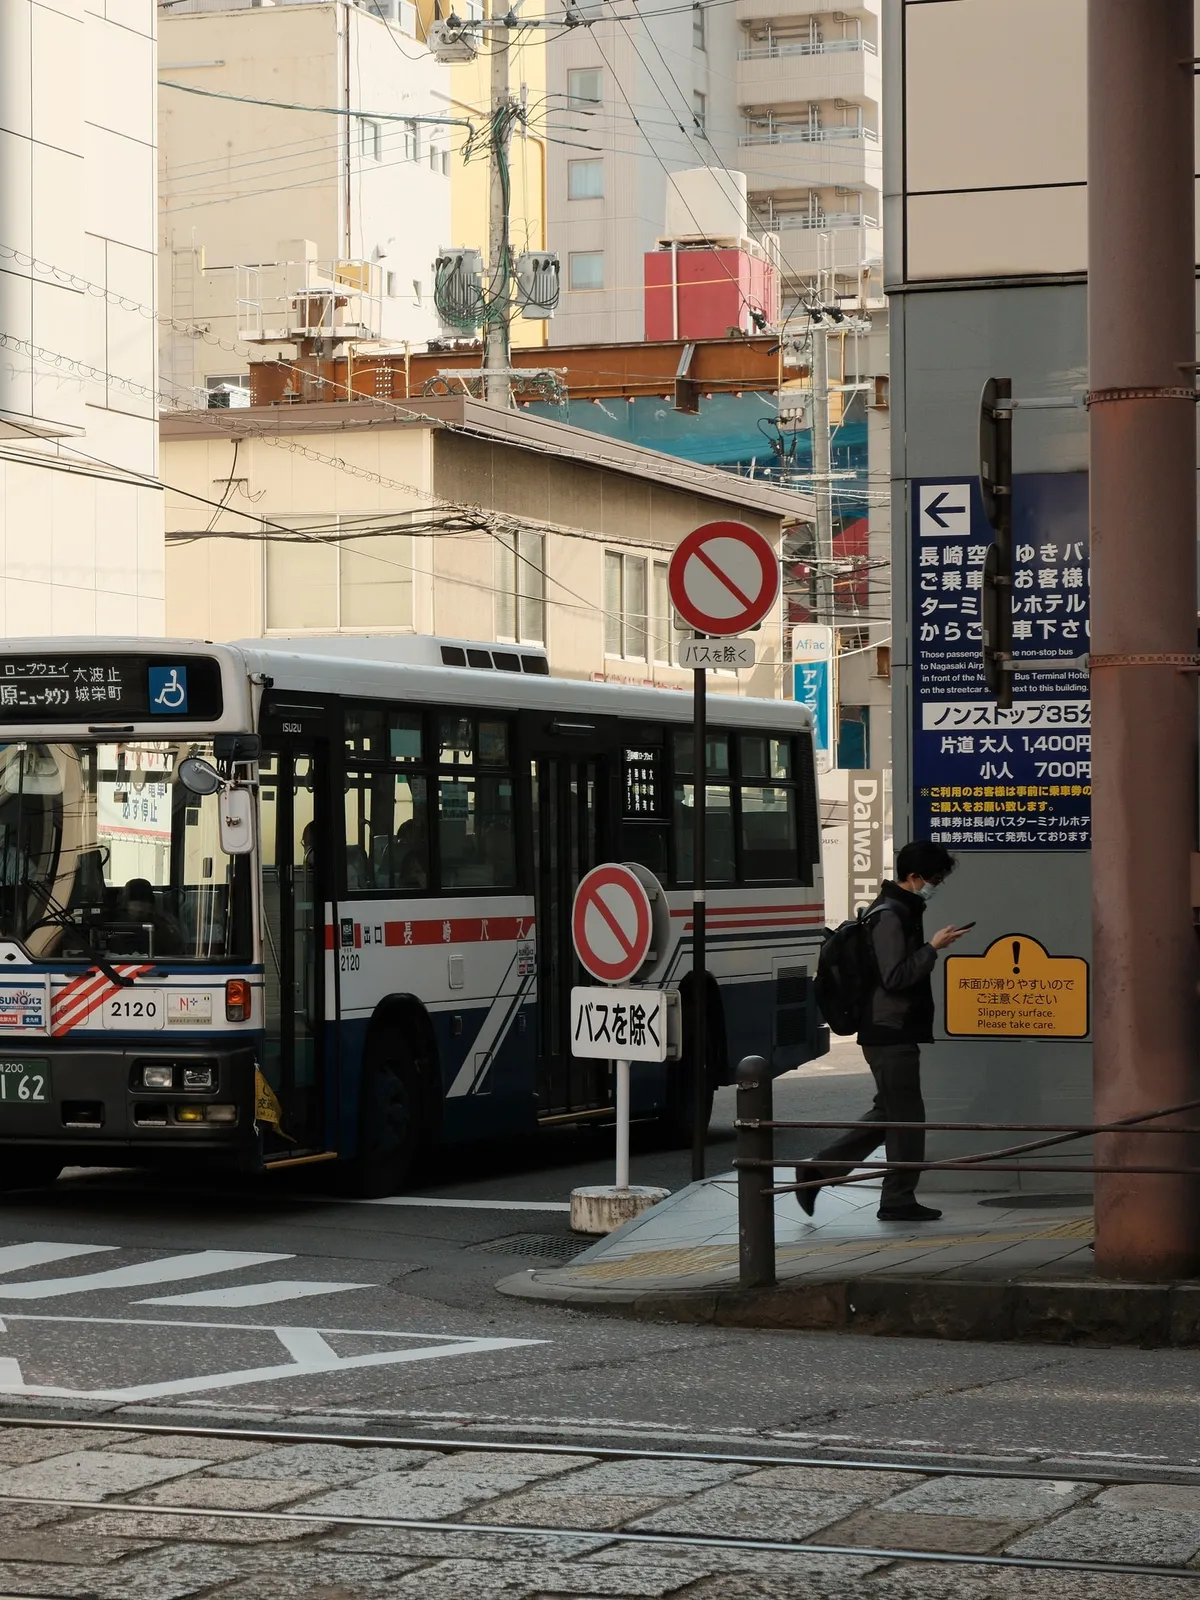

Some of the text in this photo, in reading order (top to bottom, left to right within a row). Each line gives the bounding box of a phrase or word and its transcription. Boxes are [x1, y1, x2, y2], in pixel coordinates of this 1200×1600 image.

[796, 638, 824, 650] Aflac
[686, 646, 746, 662] バスを除く
[4, 662, 69, 675] ロープウェイ
[930, 662, 966, 671] Nagasaki
[72, 666, 122, 682] 大波止
[1014, 672, 1030, 680] Bus
[1032, 672, 1066, 680] Terminal
[74, 686, 122, 702] 城栄町
[1056, 684, 1089, 693] building.
[282, 722, 302, 733] ISUZU
[940, 734, 1092, 754] 片道 大人 1,400円
[980, 761, 1092, 780] 小人 700円
[930, 800, 1054, 813] ご購入をお願い致します。
[853, 780, 880, 872] Daiwa
[930, 816, 1090, 828] 乗車券は長崎バスターミナルホテ
[364, 926, 382, 944] 出口
[341, 954, 360, 971] 2120
[958, 978, 1074, 990] 床面が滑りやすいので
[977, 993, 1058, 1005] ご注意ください
[111, 1001, 156, 1018] 2120
[978, 1008, 1055, 1018] Slippery surface.
[575, 1002, 660, 1047] バスを除く
[978, 1020, 1007, 1029] Please
[1010, 1020, 1030, 1029] take
